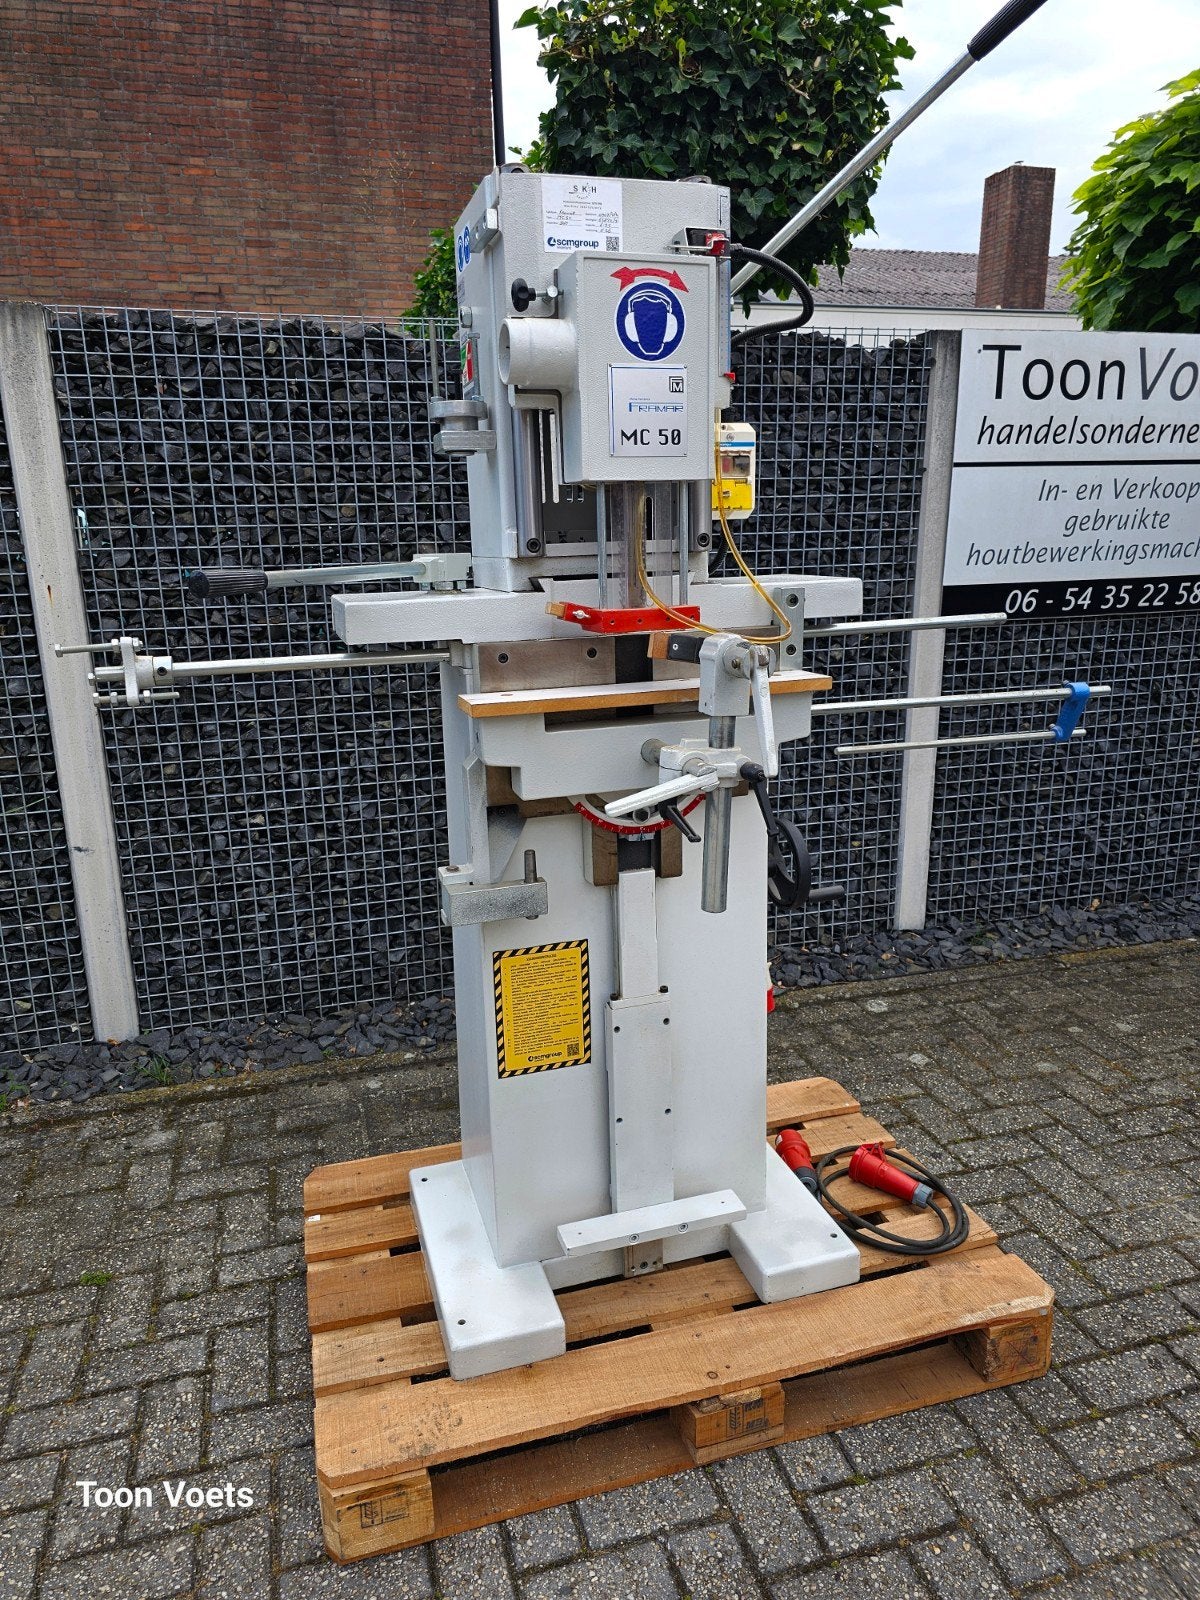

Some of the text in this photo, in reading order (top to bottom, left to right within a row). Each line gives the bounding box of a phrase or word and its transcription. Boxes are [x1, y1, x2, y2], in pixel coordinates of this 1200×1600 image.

[556, 238, 600, 249] scmgroup
[628, 402, 684, 413] FRAMAR
[620, 428, 681, 446] MC 50
[977, 415, 1200, 445] handelsonderne
[1039, 475, 1200, 504] In- en Verkoop
[1062, 506, 1171, 538] gebruikte
[1005, 588, 1039, 614] 06
[1061, 586, 1093, 611] 54
[1100, 585, 1133, 609] 35
[1137, 583, 1169, 607] 22
[1174, 582, 1200, 606] 58
